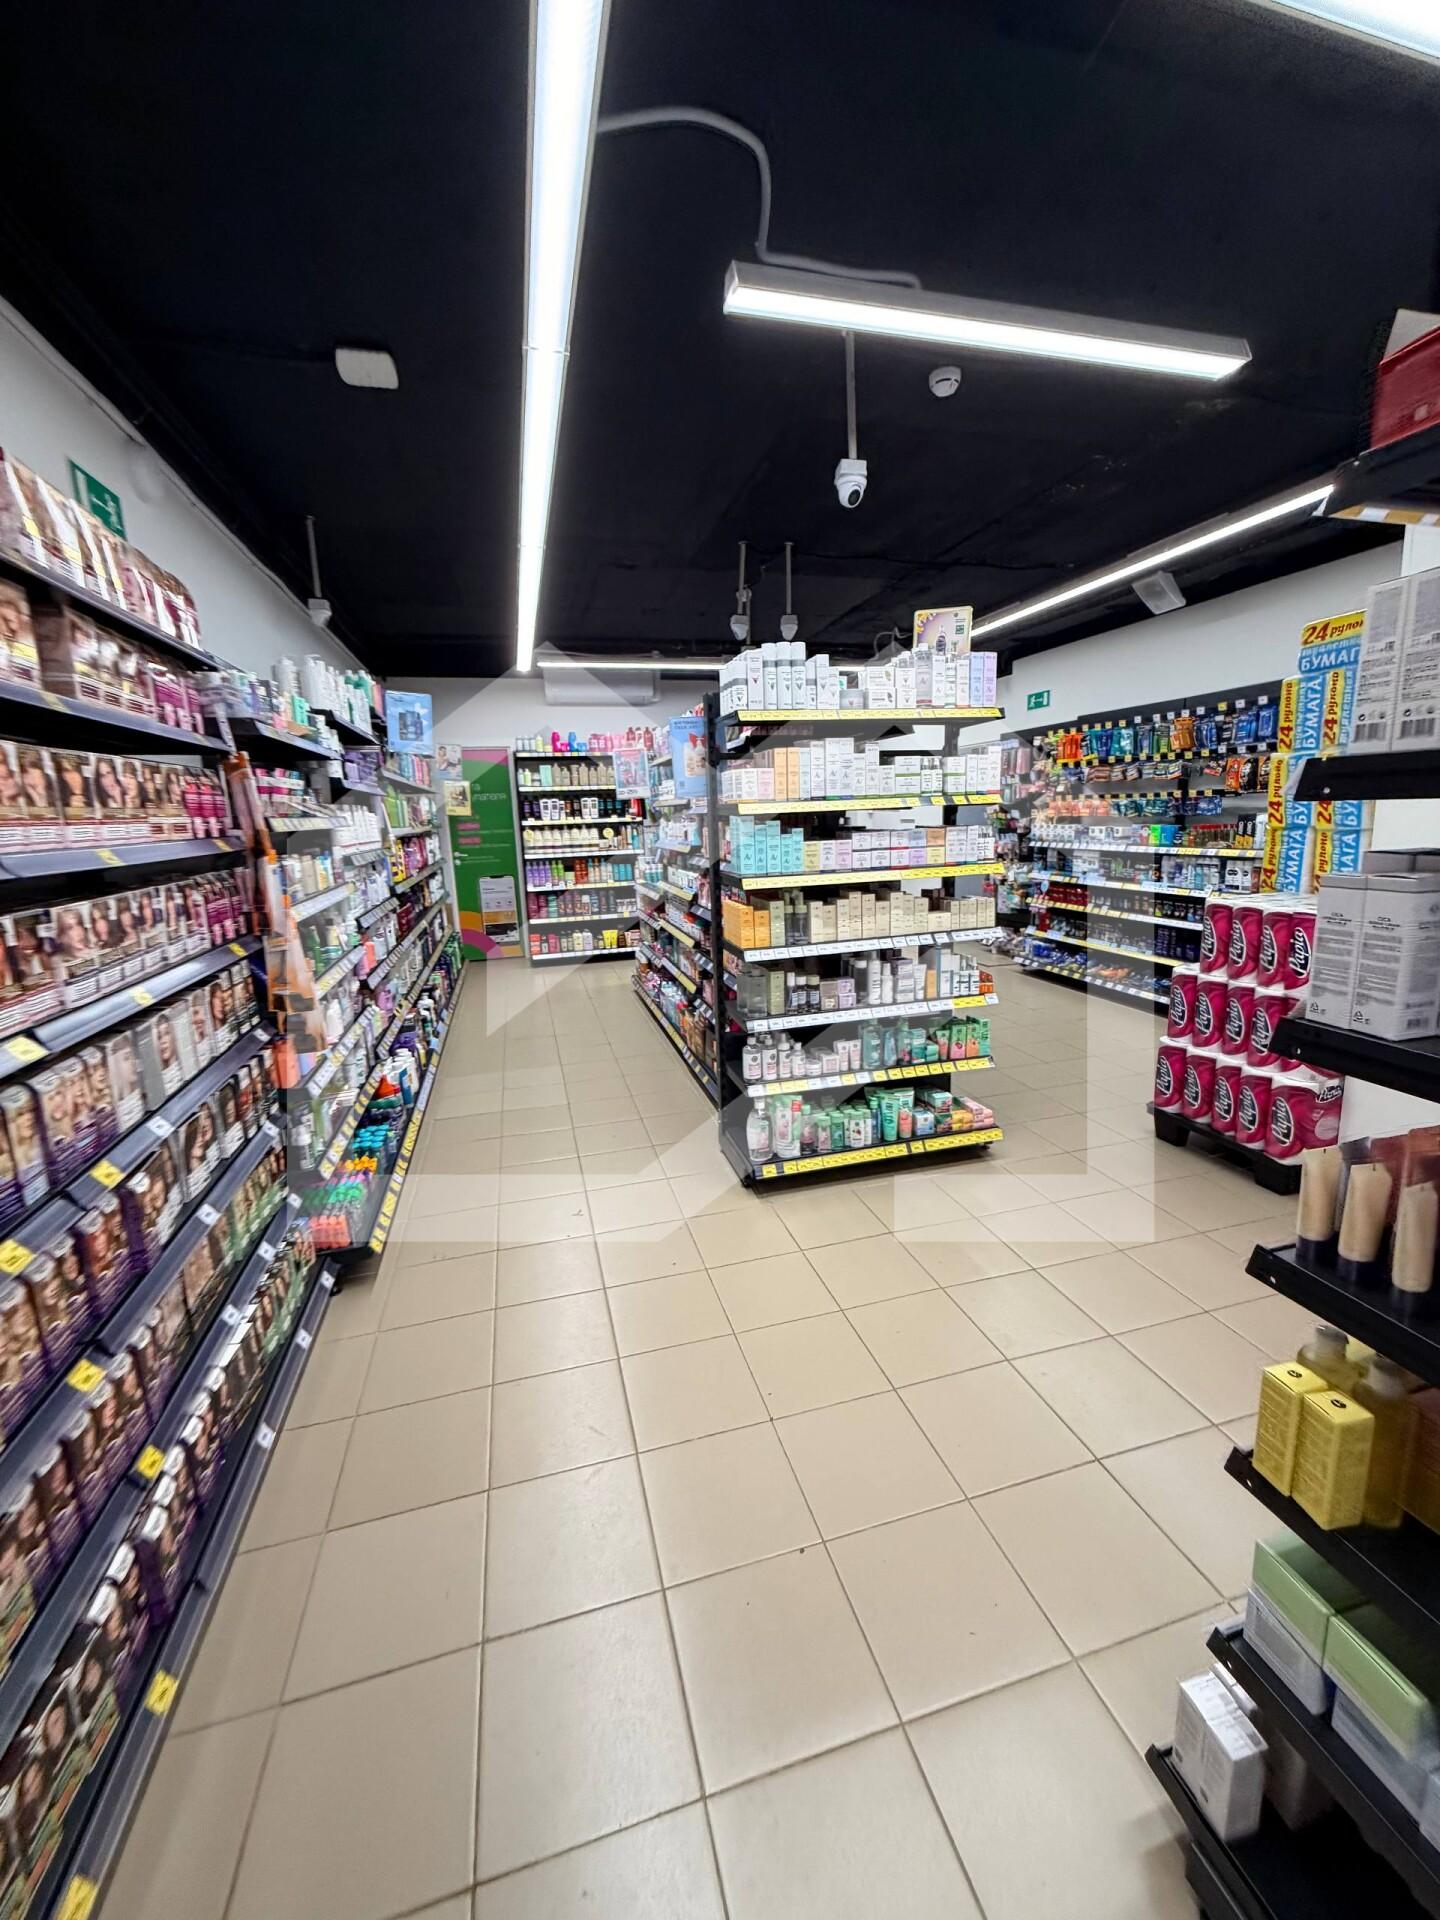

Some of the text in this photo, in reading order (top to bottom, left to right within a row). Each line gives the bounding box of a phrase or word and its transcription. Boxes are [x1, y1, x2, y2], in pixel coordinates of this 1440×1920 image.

[1302, 619, 1364, 646] 24 руло
[1301, 647, 1361, 671] БУМАГ
[1302, 677, 1322, 748] БУМАГА
[1324, 718, 1338, 744] 24
[1279, 725, 1293, 750] 24
[1268, 800, 1283, 825] 24
[1317, 800, 1332, 825] 24
[1261, 866, 1276, 890] 24
[1283, 828, 1305, 893] БУМАГА
[1201, 916, 1215, 957] Papia
[1229, 920, 1245, 964] Papia
[1260, 925, 1276, 969] Papia
[1289, 927, 1311, 974] Papia
[1170, 985, 1186, 1024] Papia
[1195, 993, 1211, 1033] Papia
[1225, 998, 1243, 1040] Papia
[1251, 1008, 1272, 1052] Papia
[1157, 1056, 1172, 1095] Papia
[1184, 1065, 1200, 1106] Papia
[1215, 1076, 1232, 1118] Papia
[1239, 1086, 1258, 1129] Papia
[1272, 1097, 1293, 1144] Papia
